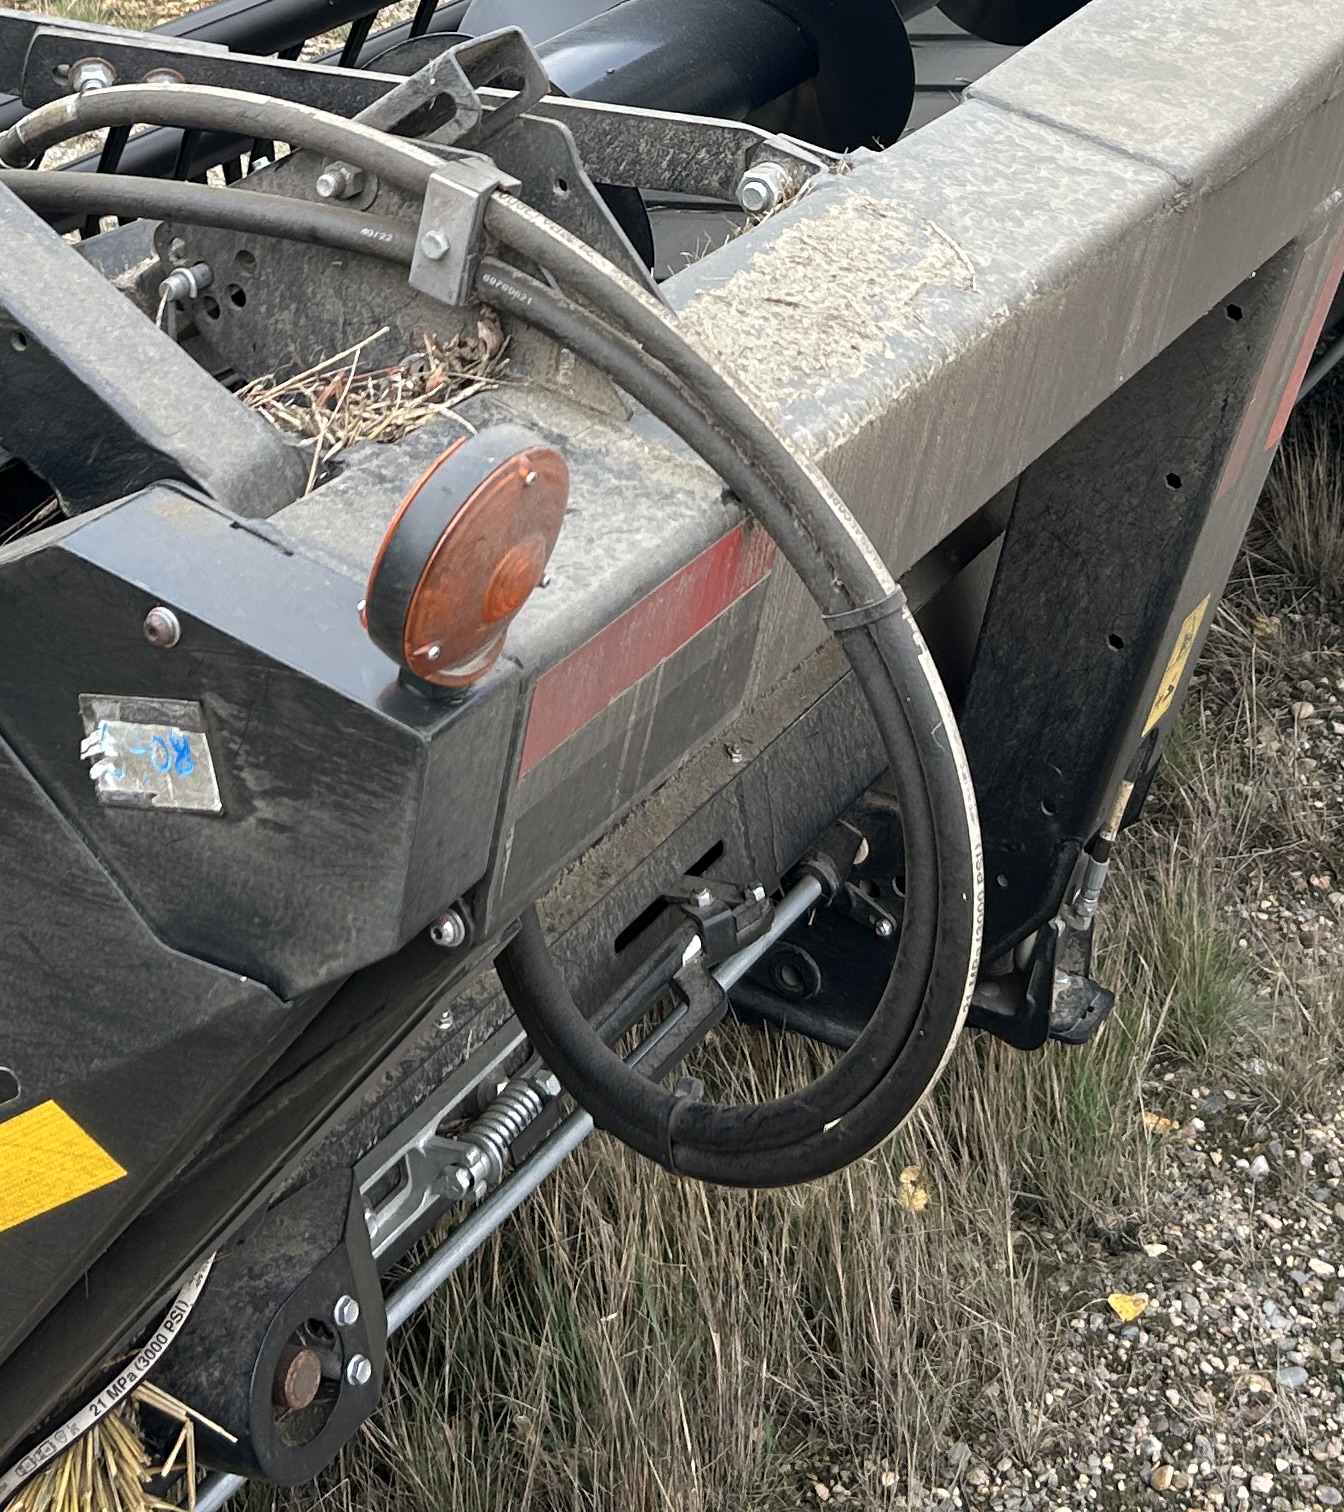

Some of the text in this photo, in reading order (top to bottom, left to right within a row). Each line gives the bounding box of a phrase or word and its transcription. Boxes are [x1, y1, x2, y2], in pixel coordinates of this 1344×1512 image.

[88, 1299, 190, 1418] 21 MPa (3000 PSI)
